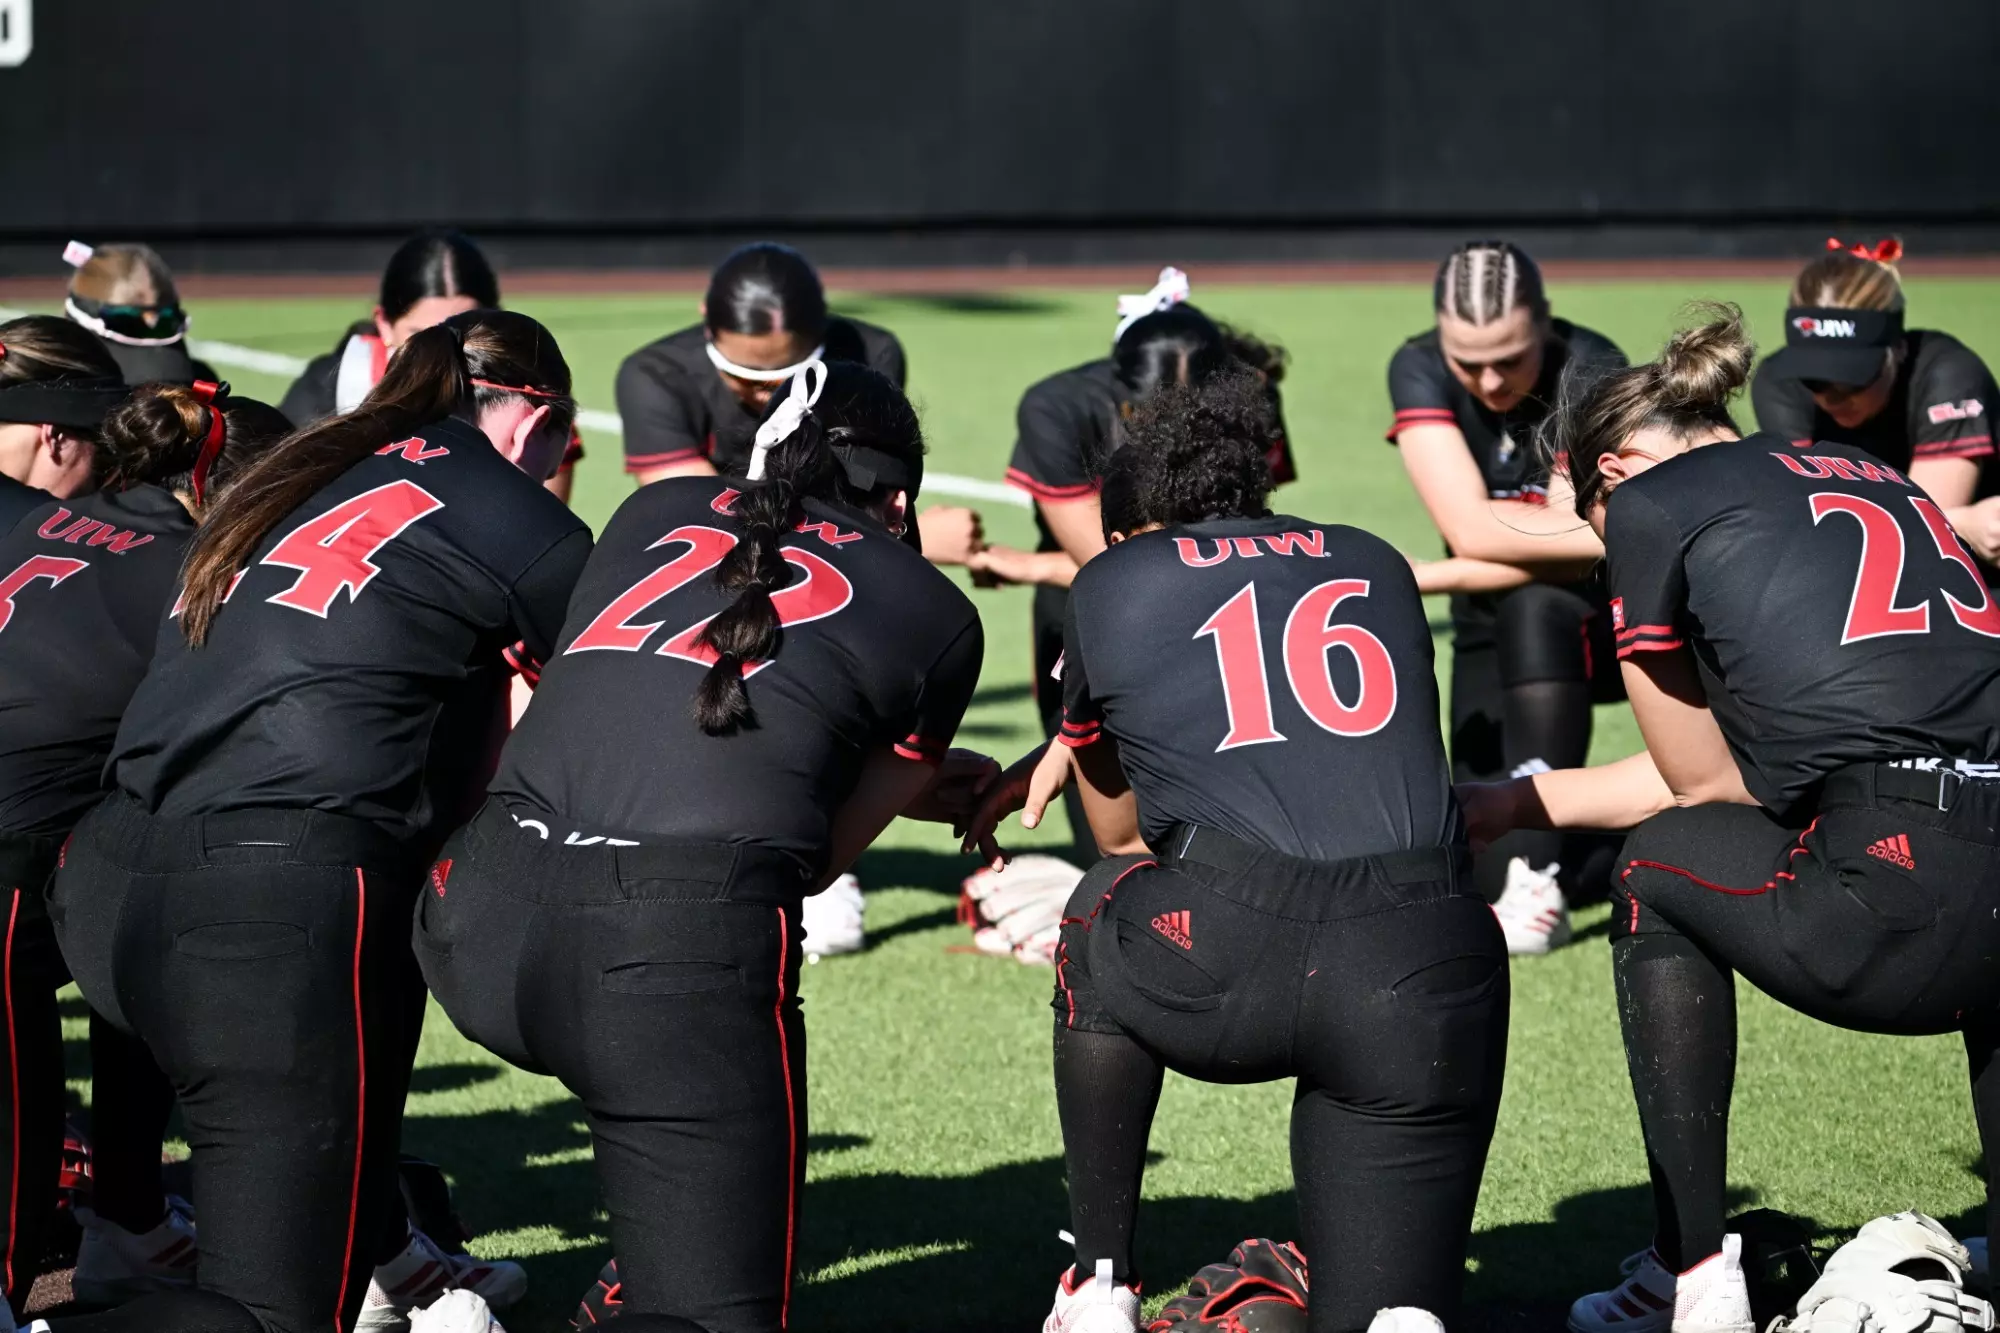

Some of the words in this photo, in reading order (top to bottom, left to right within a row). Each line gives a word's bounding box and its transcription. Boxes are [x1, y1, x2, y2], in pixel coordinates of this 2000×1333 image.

[1815, 319, 1856, 337] UIW
[1769, 452, 1912, 487] UIW
[37, 506, 155, 553] UIW
[1172, 529, 1325, 568] UIW
[563, 525, 853, 680] 22
[1192, 578, 1398, 753] 16
[1866, 845, 1915, 870] adidas
[1151, 917, 1193, 950] adidas
